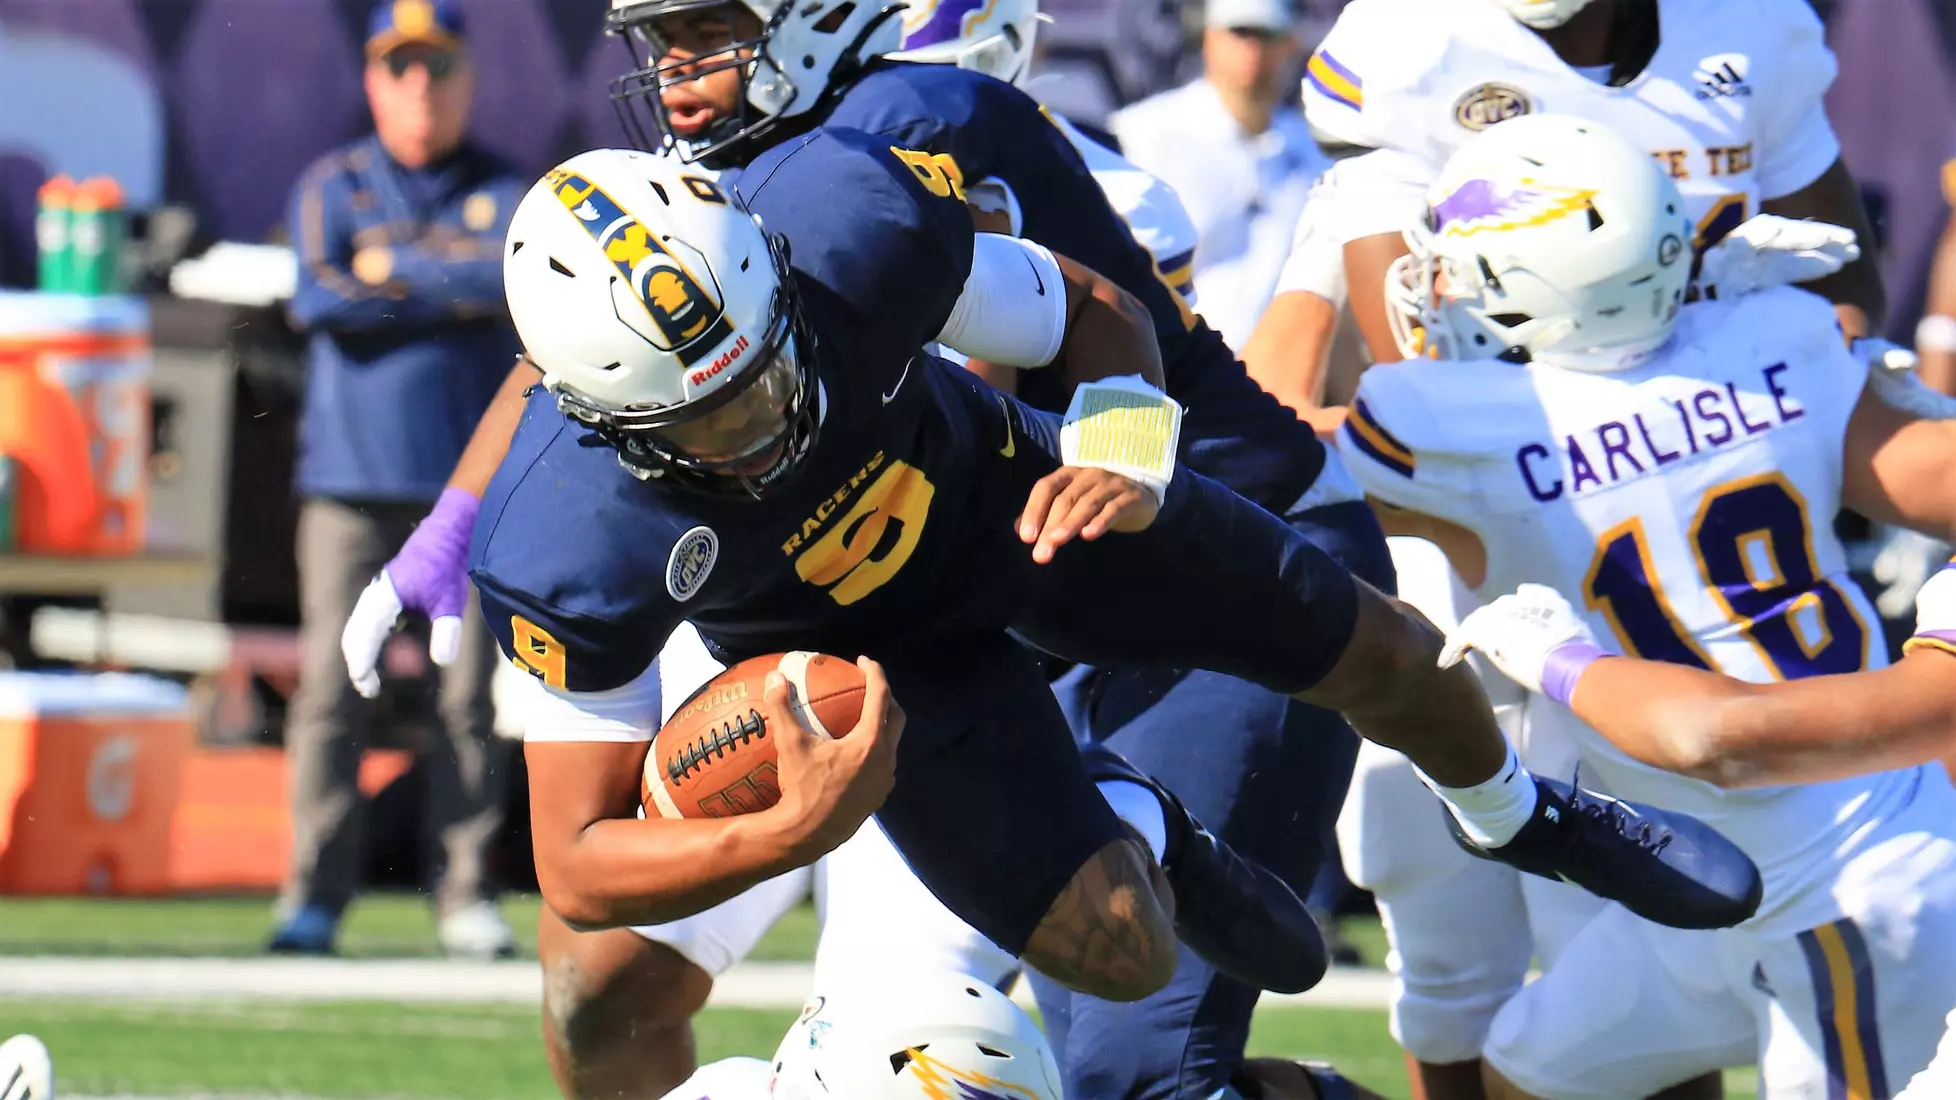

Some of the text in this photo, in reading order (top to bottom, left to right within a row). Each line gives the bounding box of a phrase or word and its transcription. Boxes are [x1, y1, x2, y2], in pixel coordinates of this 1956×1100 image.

[690, 334, 750, 387] Riddell
[759, 457, 790, 485] Riddell
[1515, 361, 1805, 502] CARLISLE
[780, 449, 886, 557] RACERS
[794, 458, 936, 606] 9
[681, 543, 706, 586] OVC
[1580, 469, 1871, 683] 18
[510, 613, 567, 690] 9
